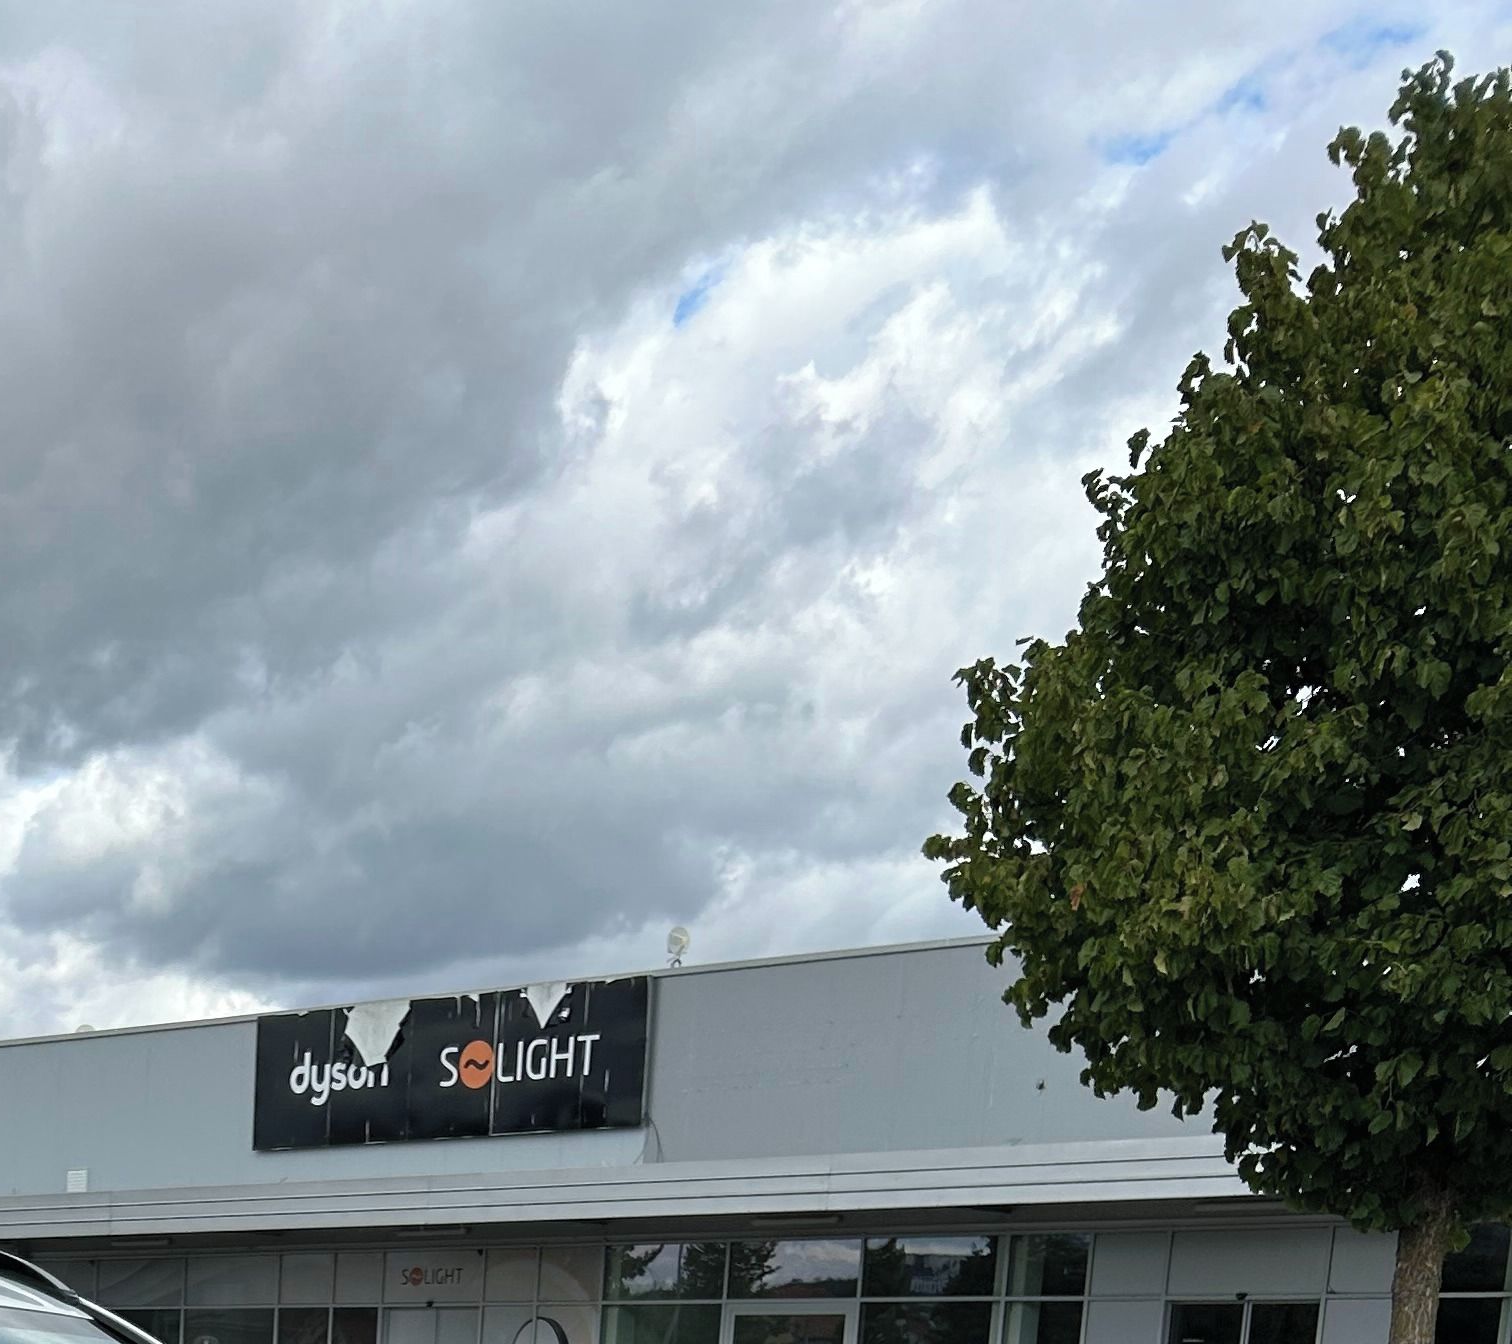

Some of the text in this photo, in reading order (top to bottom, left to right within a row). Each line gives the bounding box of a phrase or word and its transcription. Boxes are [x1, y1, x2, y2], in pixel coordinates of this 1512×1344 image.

[289, 1051, 388, 1106] dyson
[439, 1034, 600, 1089] SOLIGHT
[400, 1267, 464, 1287] SOLIGHT
